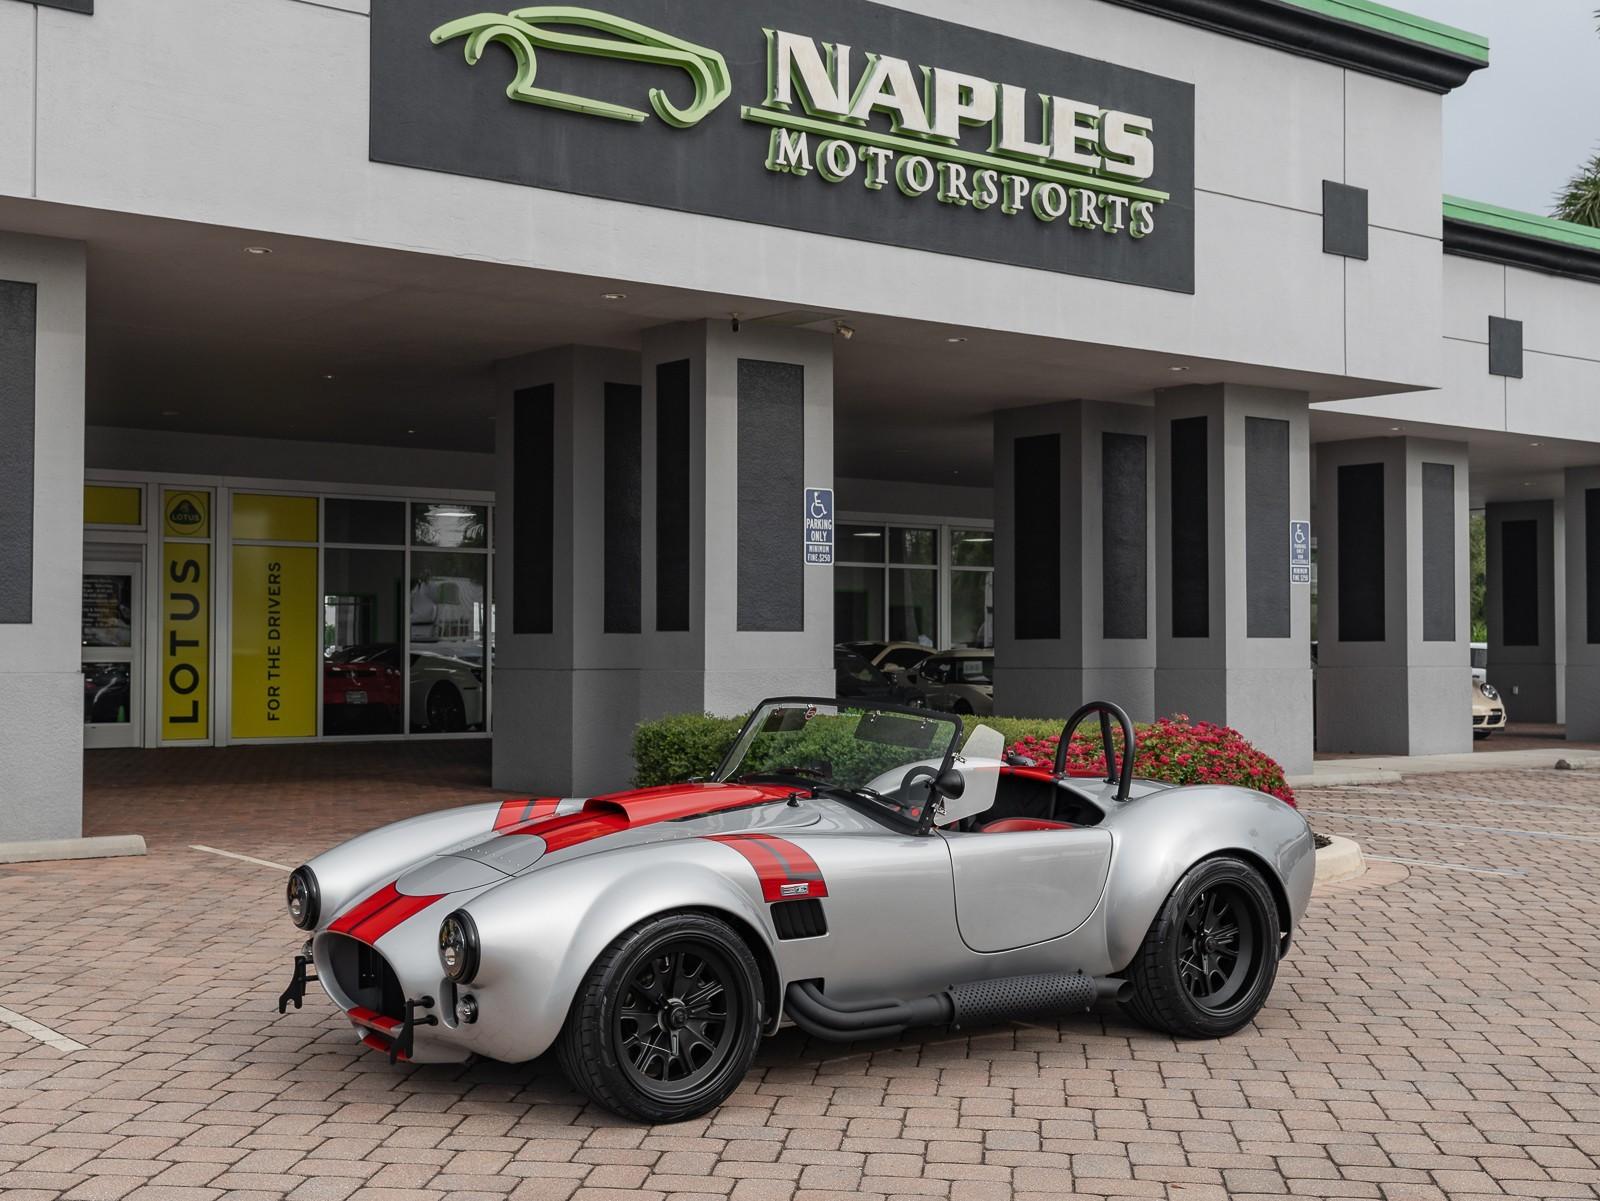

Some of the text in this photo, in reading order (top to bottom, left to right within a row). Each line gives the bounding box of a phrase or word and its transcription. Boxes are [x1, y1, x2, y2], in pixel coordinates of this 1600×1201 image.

[763, 28, 1154, 182] NAPLES
[765, 128, 1154, 238] MOTORSPORTS
[806, 518, 832, 530] PARKING
[810, 530, 827, 541] ONLY
[169, 559, 200, 723] LOTUS
[267, 562, 281, 721] FOR THE DRIVERS
